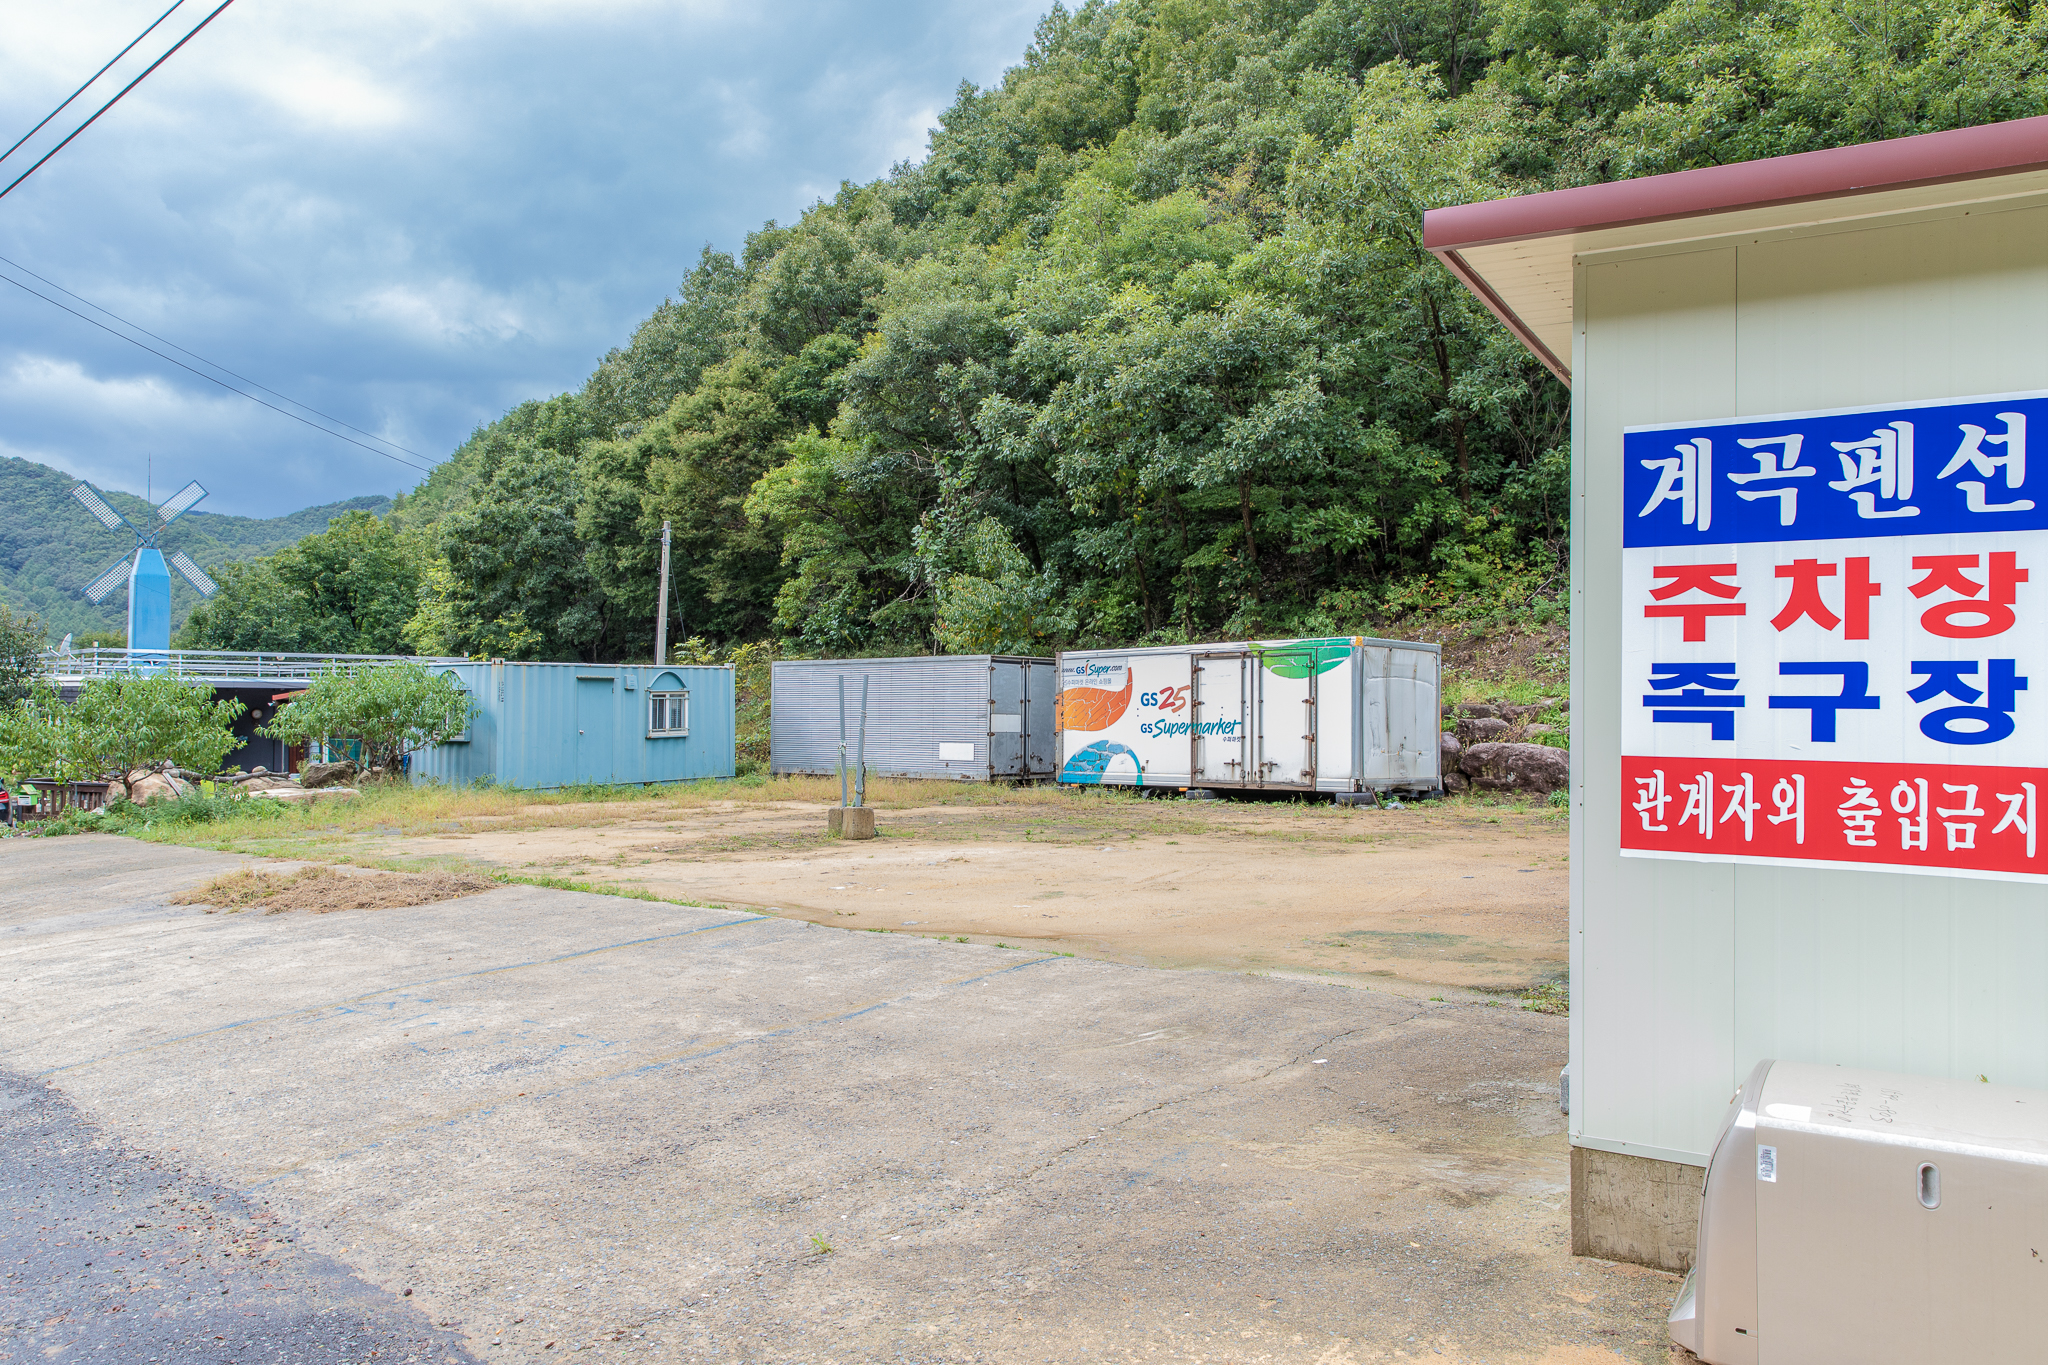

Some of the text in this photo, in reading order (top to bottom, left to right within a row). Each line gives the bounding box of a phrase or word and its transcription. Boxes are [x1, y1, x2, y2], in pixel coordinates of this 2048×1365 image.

[1638, 411, 2036, 532] 계곡펜션
[1644, 550, 2029, 643] 주차장
[1140, 684, 1191, 714] GS25
[1152, 717, 1242, 739] Supermarket
[1642, 658, 2029, 746] 족구장
[1631, 768, 2037, 858] 관계자외 출입금지
